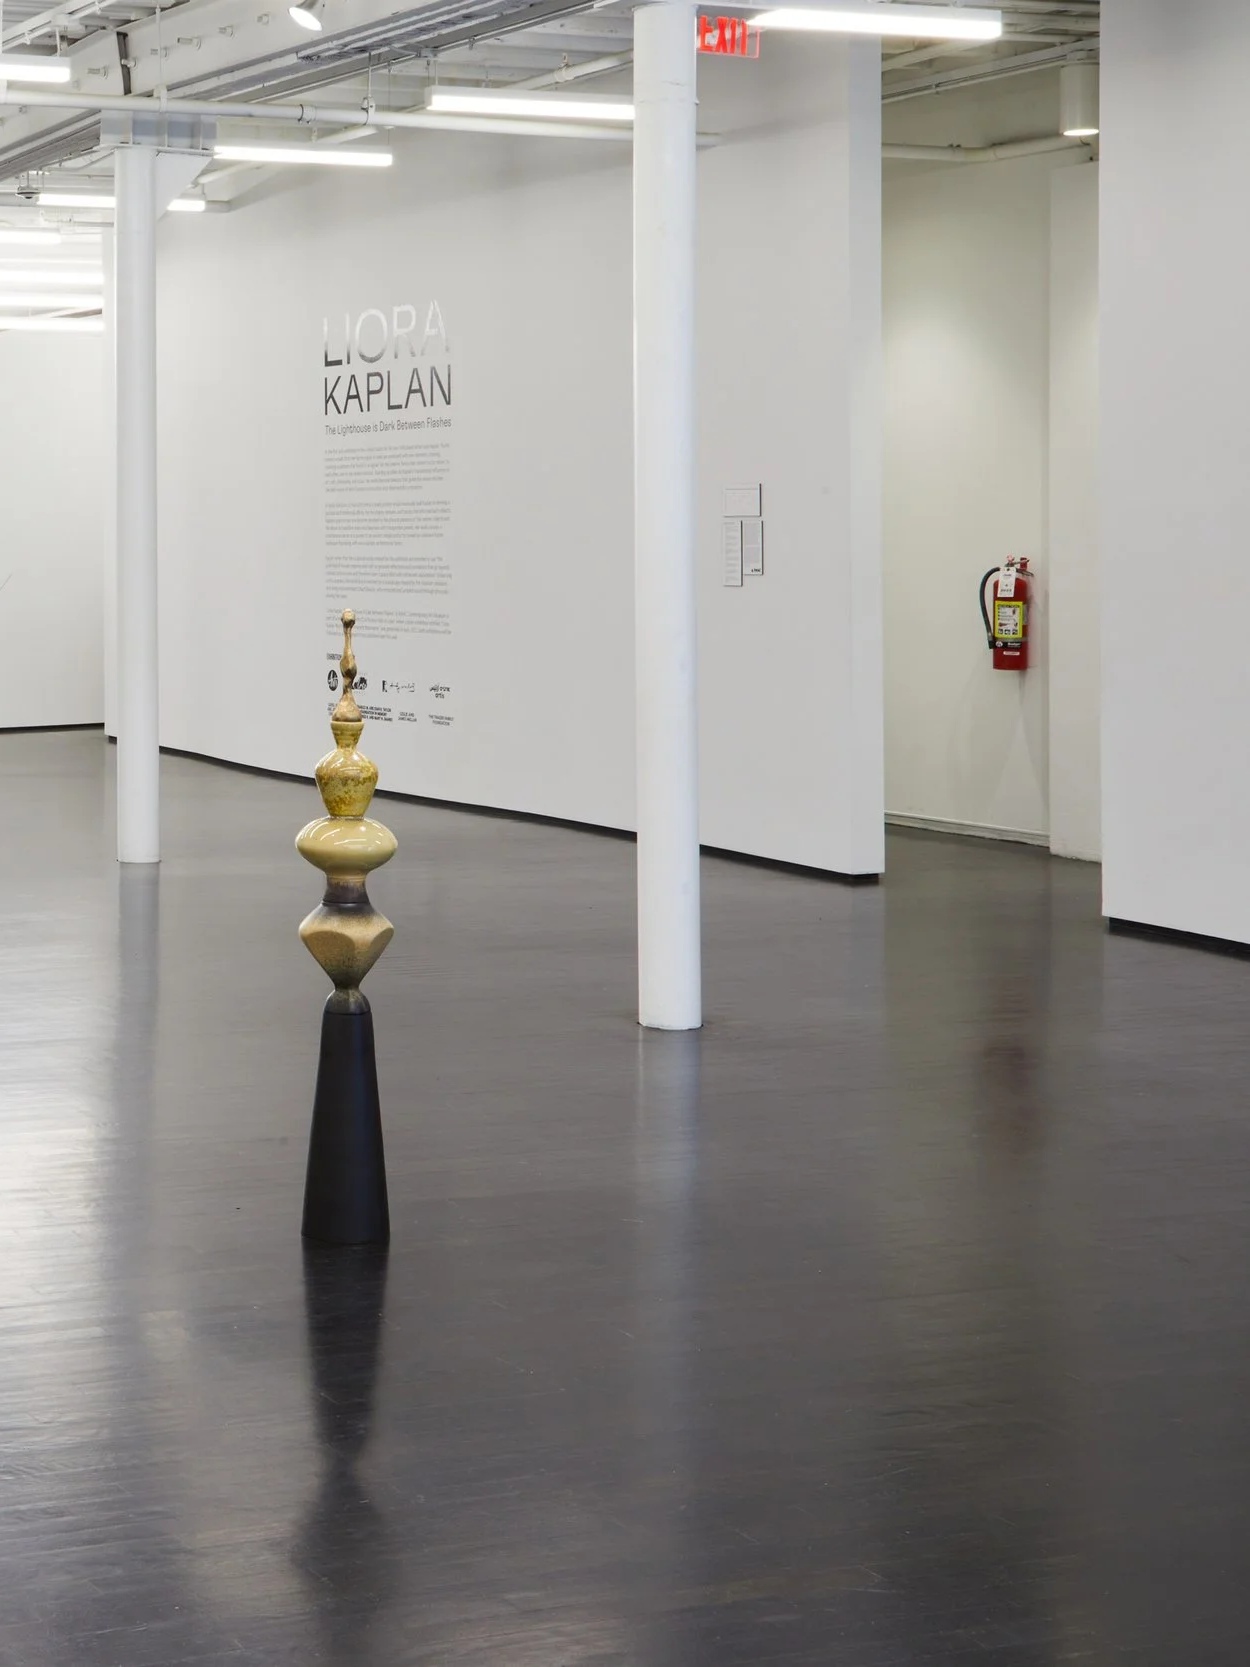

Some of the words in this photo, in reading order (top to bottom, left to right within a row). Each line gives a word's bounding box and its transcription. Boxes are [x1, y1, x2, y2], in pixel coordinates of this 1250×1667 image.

[323, 299, 451, 367] LIORA
[324, 364, 452, 416] KAPLAN
[325, 425, 336, 436] The
[337, 423, 372, 437] Lighthouse
[372, 423, 379, 433] is
[379, 421, 396, 432] Dark
[396, 419, 426, 431] Between
[426, 417, 452, 429] Flashes
